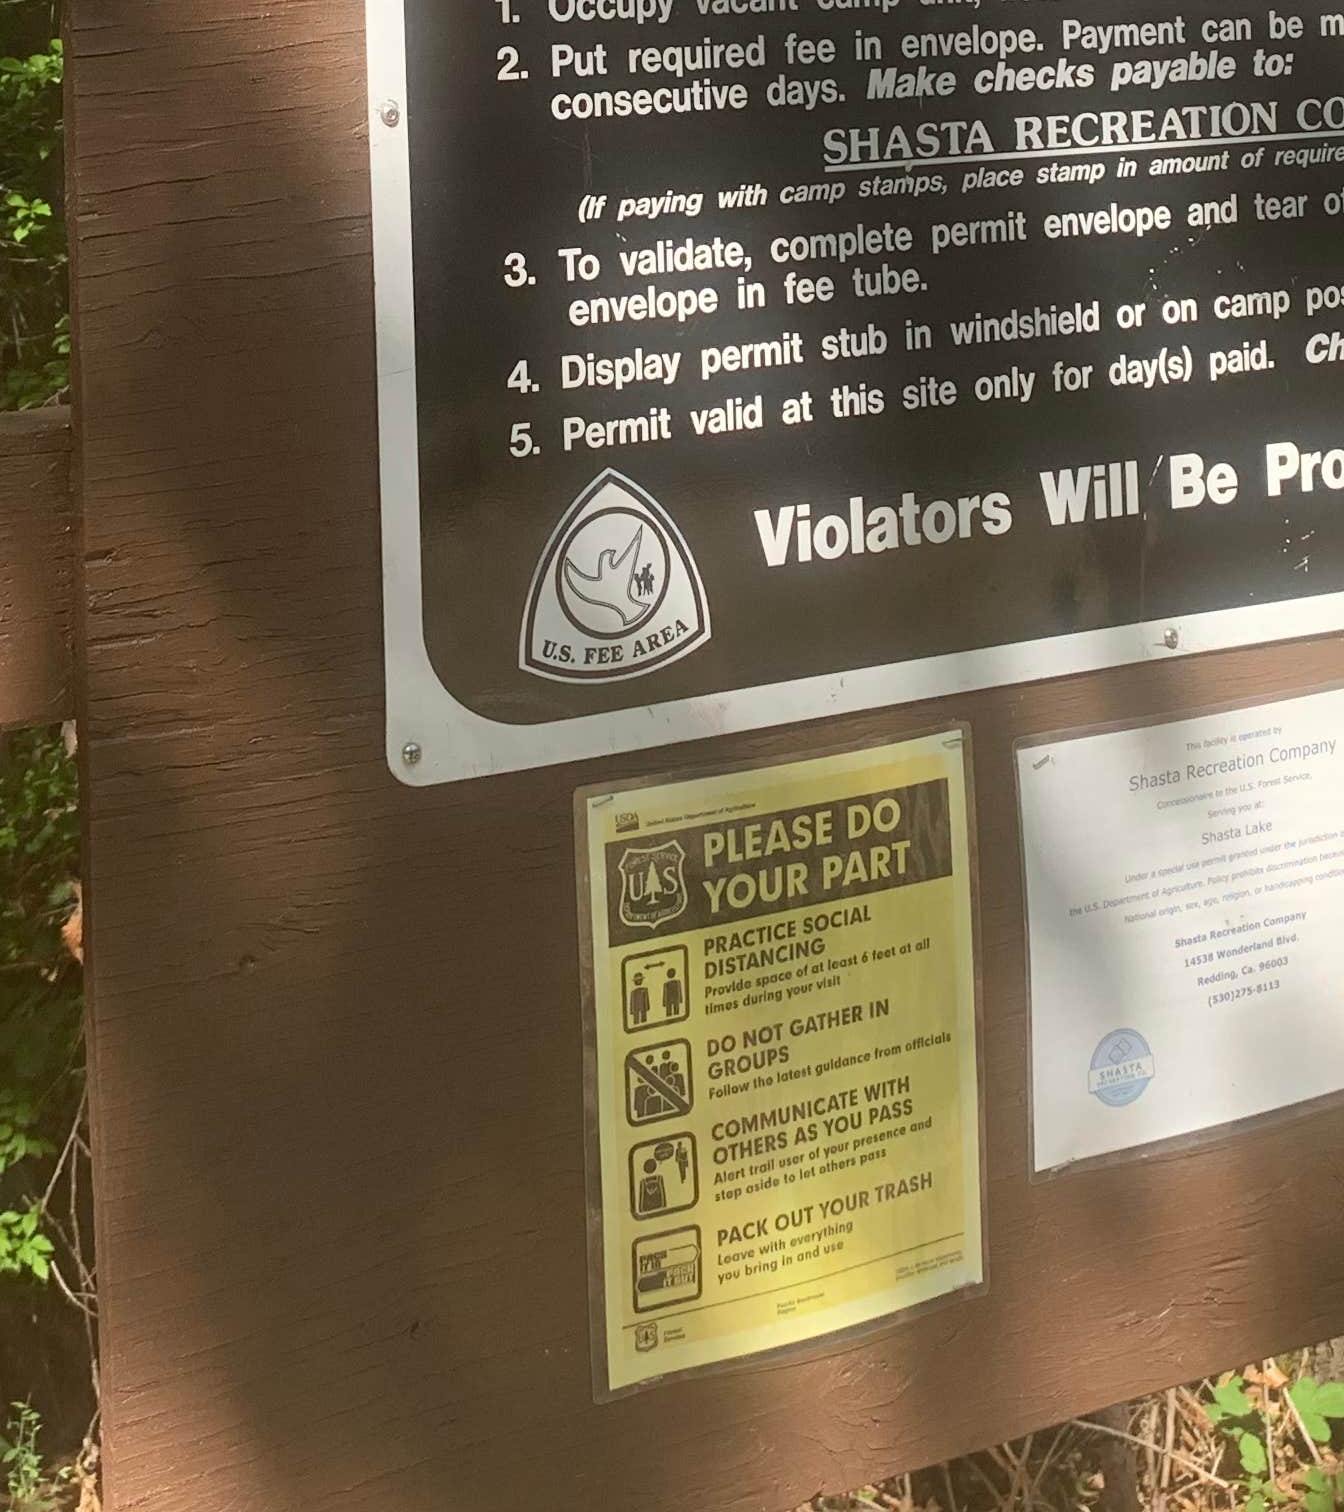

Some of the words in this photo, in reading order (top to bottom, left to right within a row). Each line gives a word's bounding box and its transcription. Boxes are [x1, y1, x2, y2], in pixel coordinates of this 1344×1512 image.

[824, 119, 994, 164] SHASTA
[1016, 102, 1277, 150] RECREATION
[754, 492, 1012, 566] Violators
[1040, 461, 1138, 525] Will
[1170, 453, 1239, 510] Be
[542, 639, 575, 664] U.S.
[583, 645, 624, 665] FEE
[632, 619, 689, 658] AREA
[1129, 769, 1180, 791] Shasta
[1187, 754, 1264, 781] Recreation
[1270, 740, 1336, 763] Company
[704, 810, 832, 867] PLEASE
[848, 798, 900, 839] DO
[1202, 828, 1241, 845] Shasta
[1246, 821, 1272, 835] Lake
[703, 863, 808, 913] YOUR
[823, 840, 910, 890] PART
[704, 920, 796, 956] PRACTICE
[803, 905, 871, 934] SOCIAL
[1175, 934, 1207, 948] Shasta
[1210, 922, 1260, 940] Recreation
[1264, 912, 1306, 927] Company
[1216, 938, 1273, 959] Wonderland
[1276, 934, 1298, 946] Blvd.
[705, 938, 825, 979] DISTANCING
[1198, 971, 1238, 986] Redding,
[1242, 966, 1256, 975] Ca.
[1259, 956, 1288, 972] 96003
[708, 1035, 736, 1057] DO
[743, 1024, 783, 1048] NOT
[790, 1006, 862, 1036] GATHER
[870, 998, 888, 1018] IN
[708, 1046, 789, 1080] GROUPS
[718, 1218, 768, 1246] PACK
[775, 1206, 814, 1230] OUT
[819, 1191, 869, 1219] YOUR
[874, 1172, 932, 1202] TRASH
